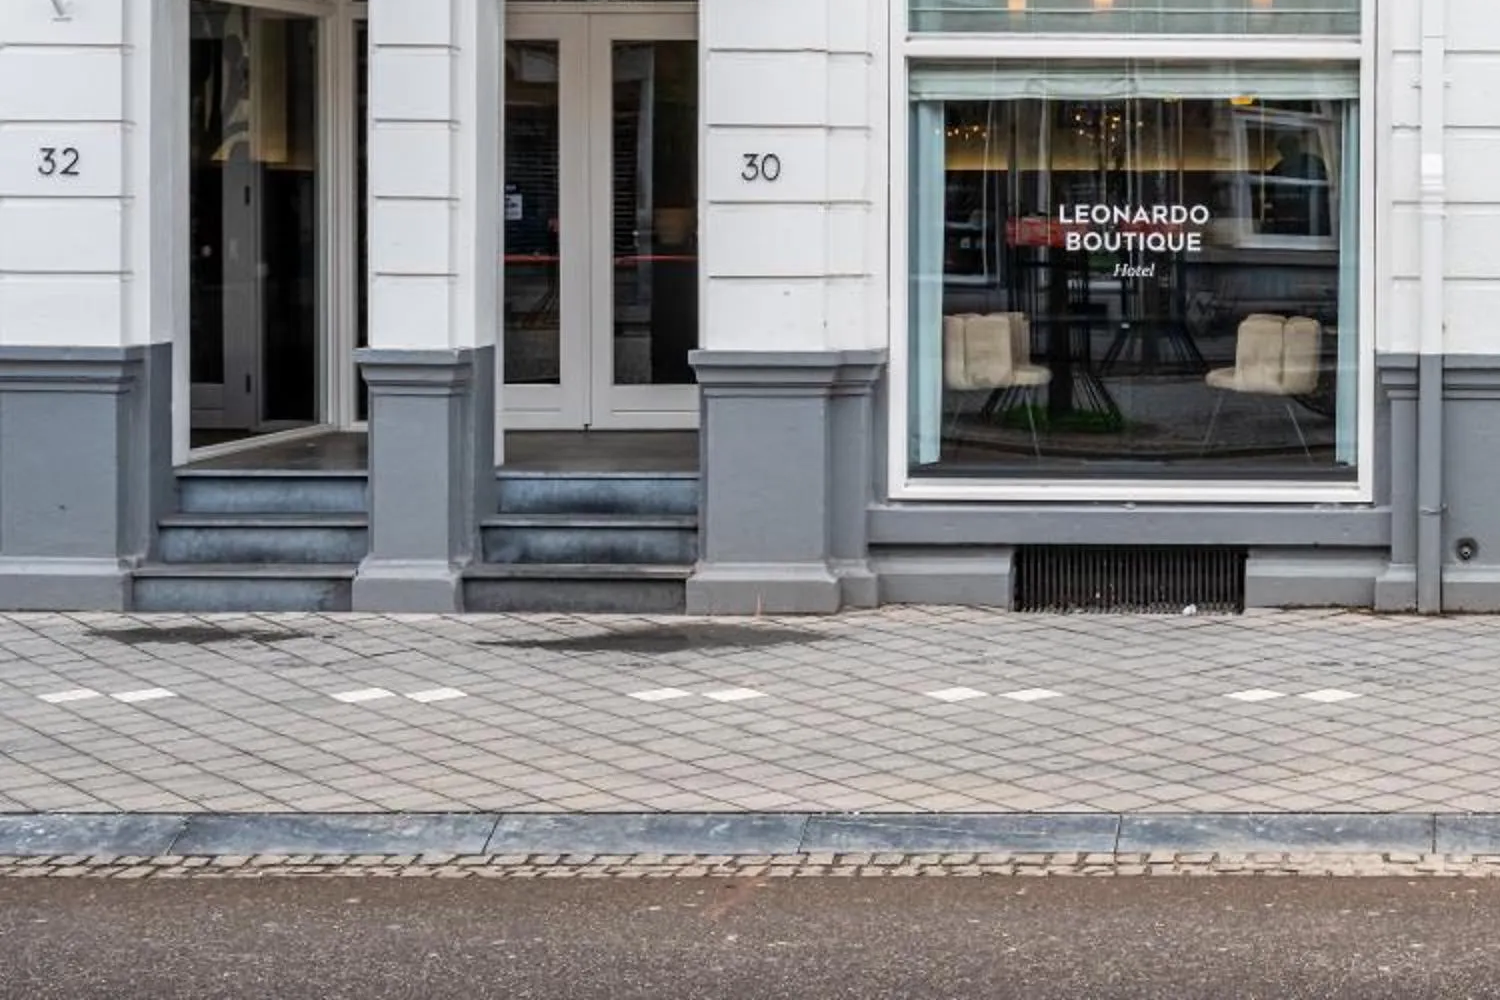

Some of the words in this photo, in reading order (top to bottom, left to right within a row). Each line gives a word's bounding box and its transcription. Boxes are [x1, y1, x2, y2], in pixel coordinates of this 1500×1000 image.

[38, 147, 80, 176] 32
[741, 153, 781, 182] 30
[1059, 203, 1209, 225] LEONARDO
[1066, 231, 1202, 252] BOUTIQUE
[1113, 261, 1155, 278] Hotel
